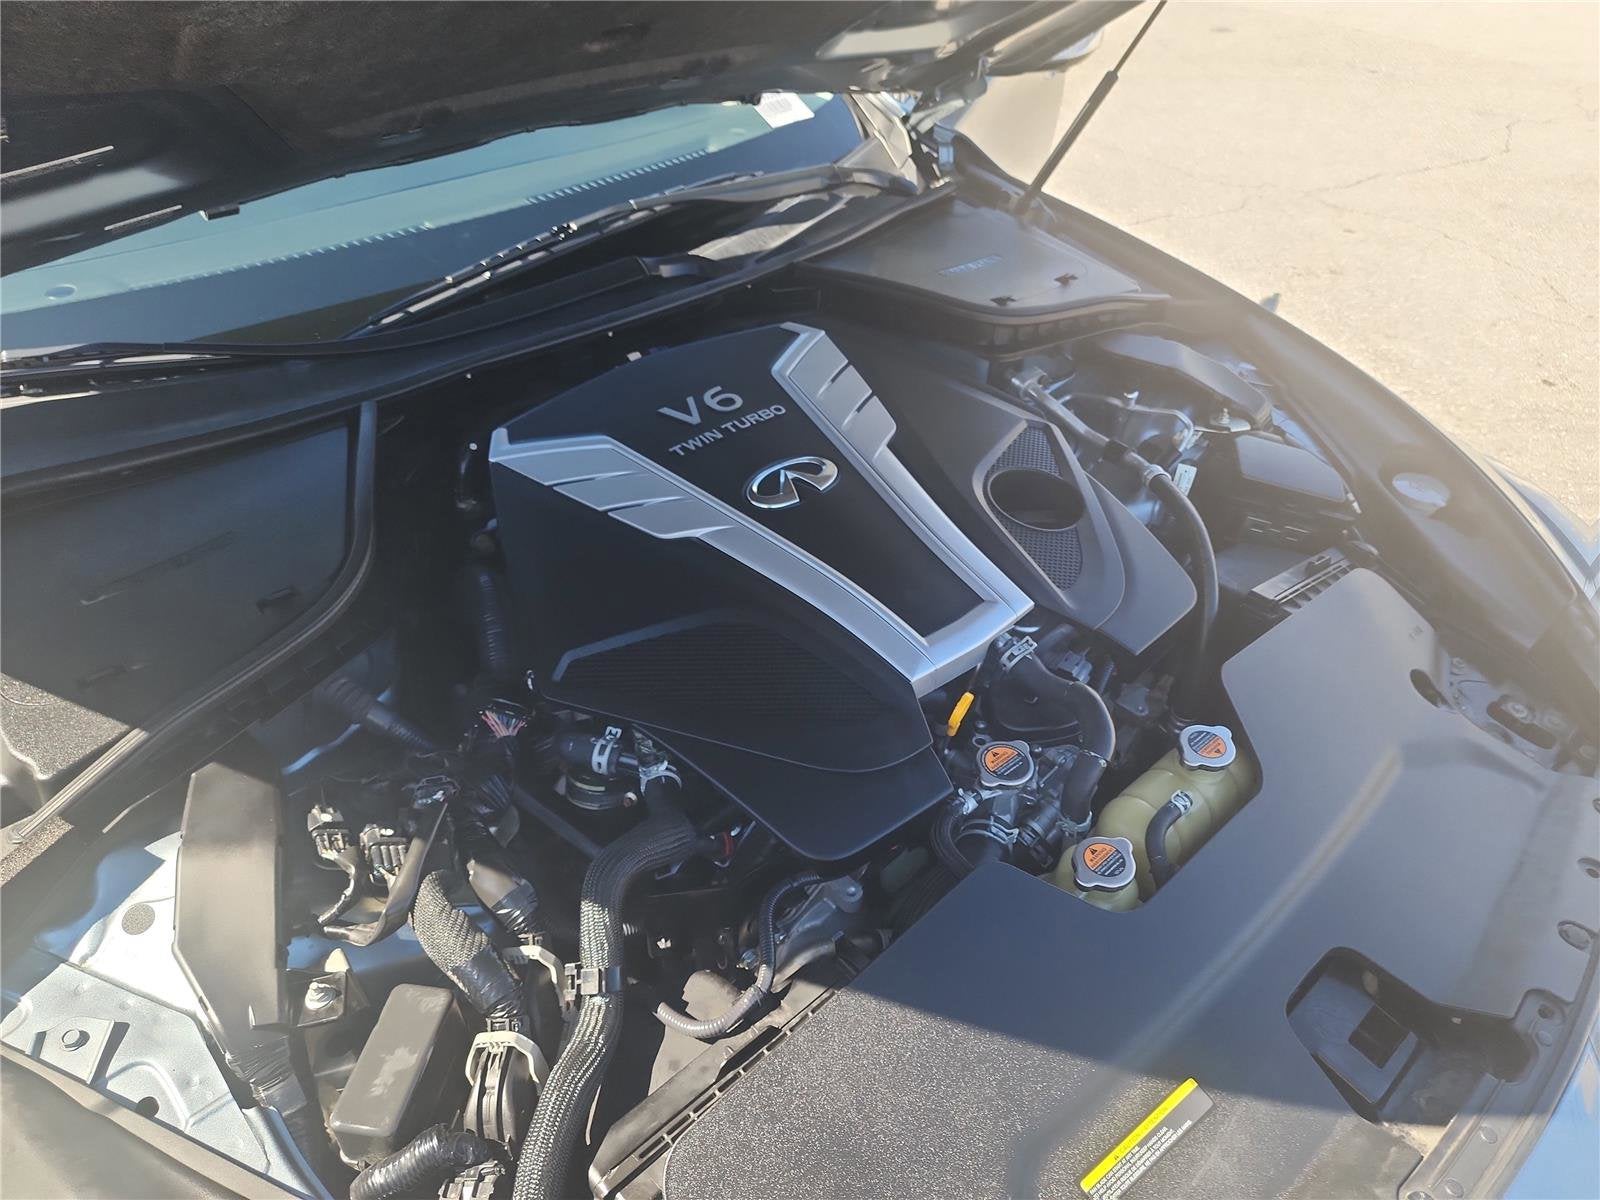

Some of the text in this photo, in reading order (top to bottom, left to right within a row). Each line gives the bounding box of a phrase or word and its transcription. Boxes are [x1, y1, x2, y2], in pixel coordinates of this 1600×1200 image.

[657, 385, 743, 425] V6
[668, 404, 786, 456] TWIN TURBO
